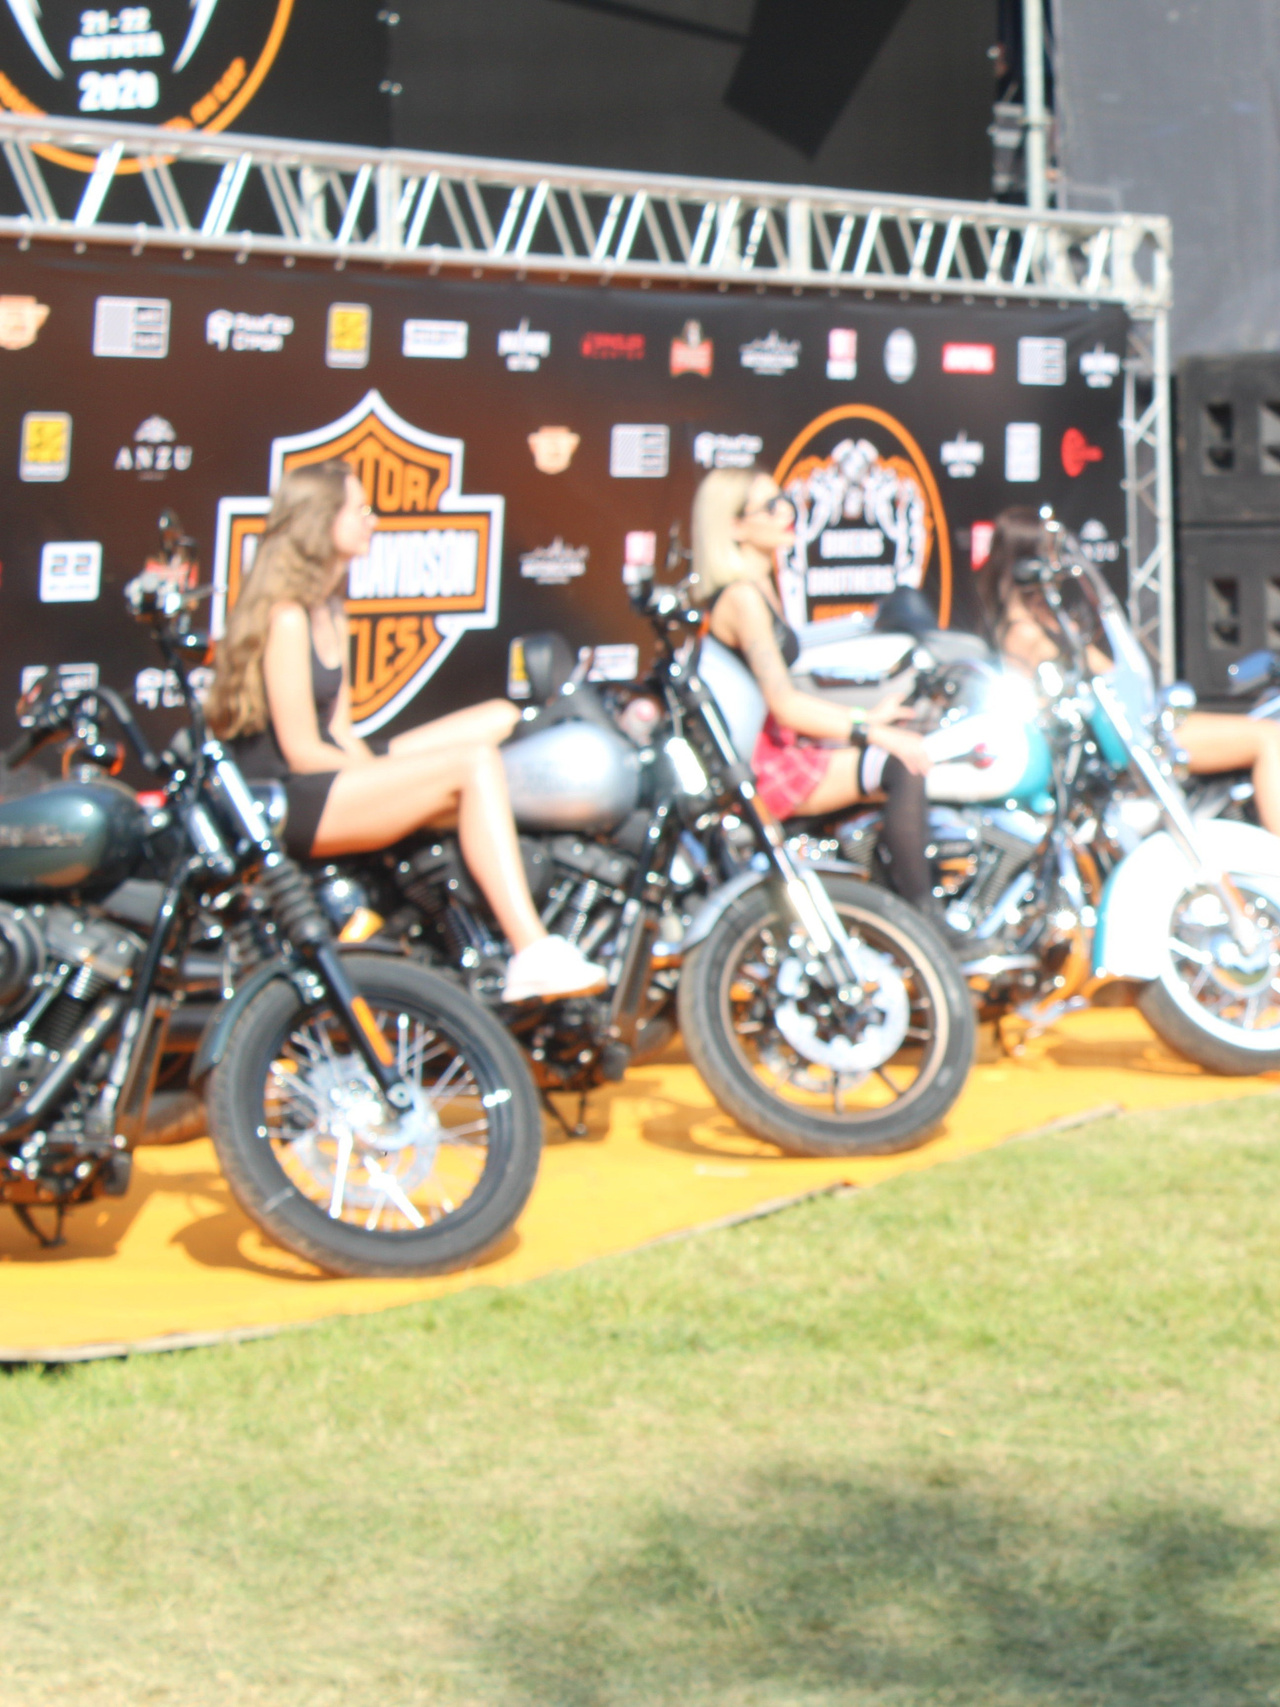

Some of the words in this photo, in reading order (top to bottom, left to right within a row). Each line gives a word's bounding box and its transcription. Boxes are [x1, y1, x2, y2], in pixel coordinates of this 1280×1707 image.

[78, 69, 159, 112] 2020
[114, 445, 193, 471] ANZU
[346, 434, 428, 511] TOR
